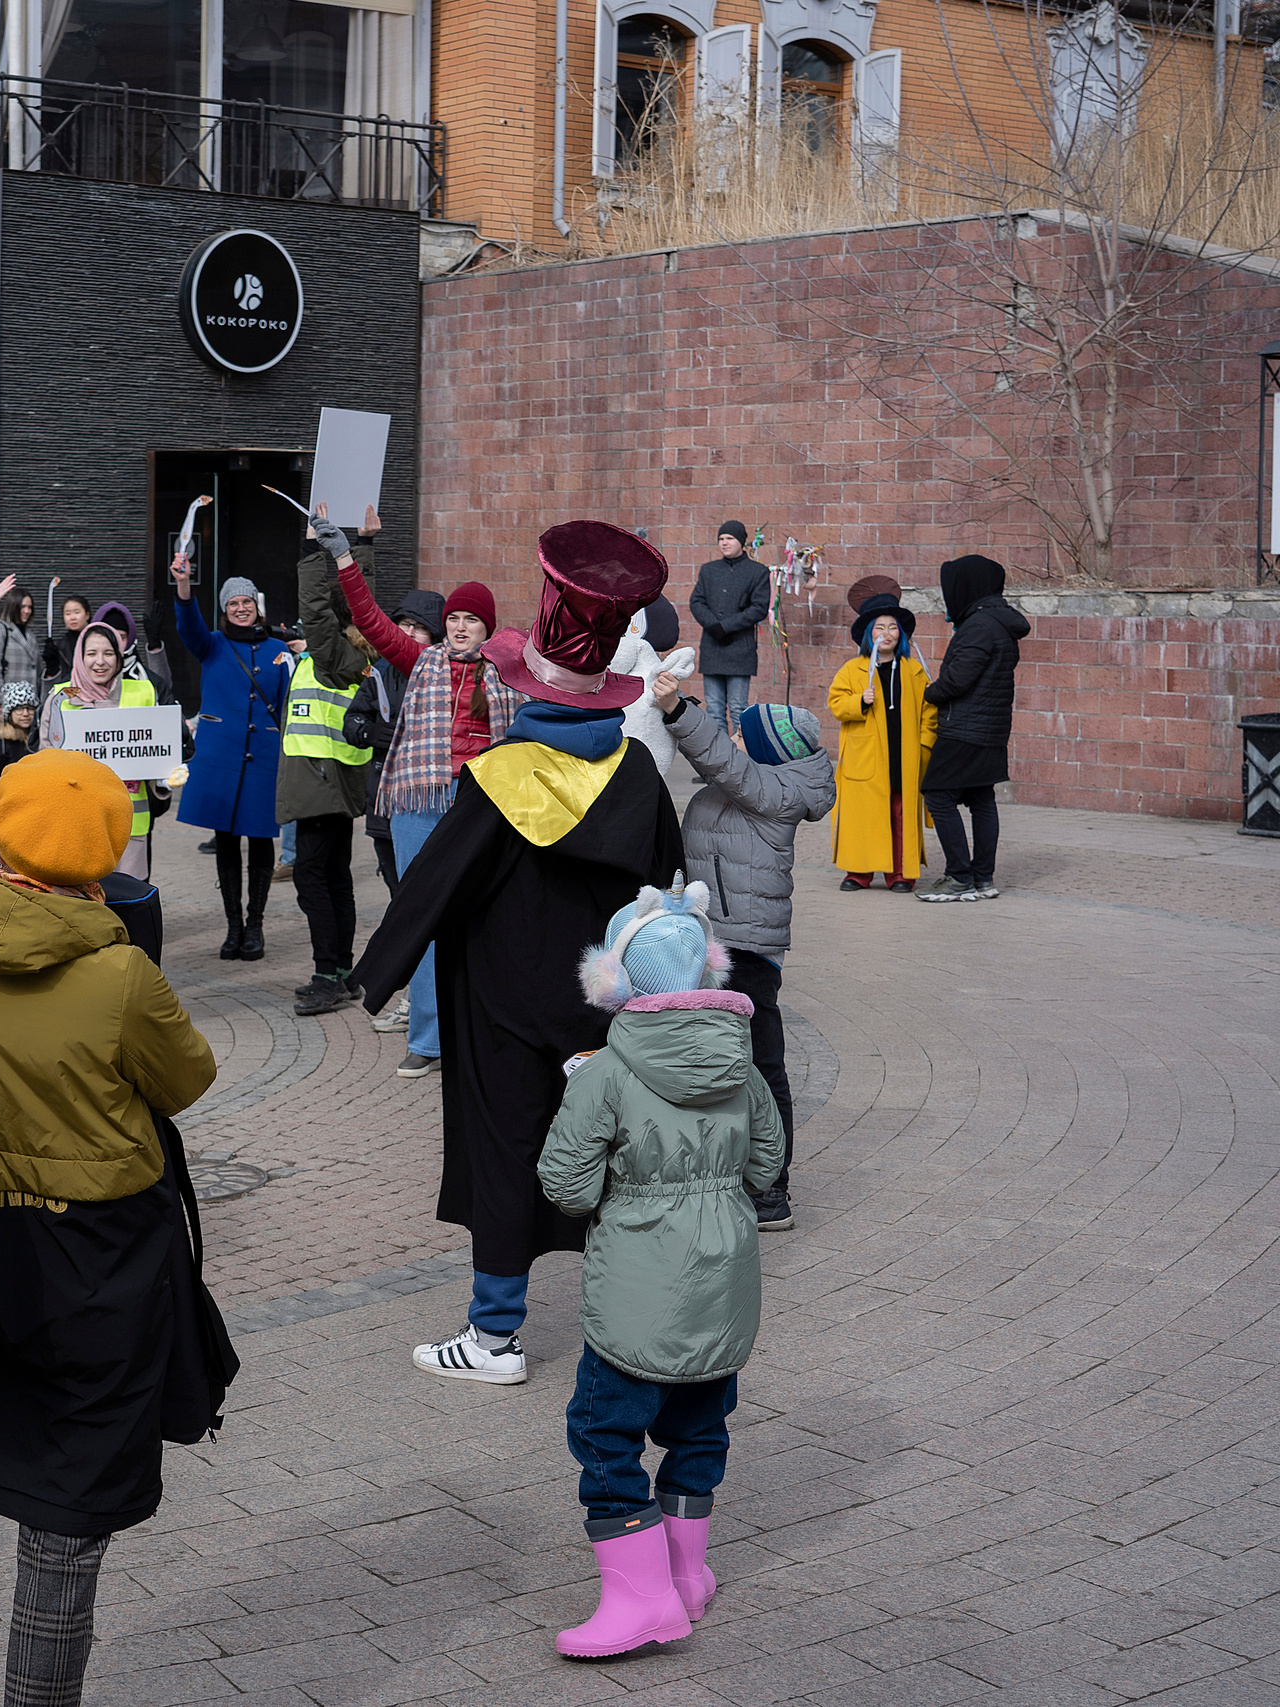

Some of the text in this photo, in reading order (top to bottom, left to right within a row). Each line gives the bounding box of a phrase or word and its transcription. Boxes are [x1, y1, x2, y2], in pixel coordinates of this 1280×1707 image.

[85, 728, 153, 743] МЕСТО ДЛЯ
[112, 744, 172, 759] РЕКЛАМЫ
